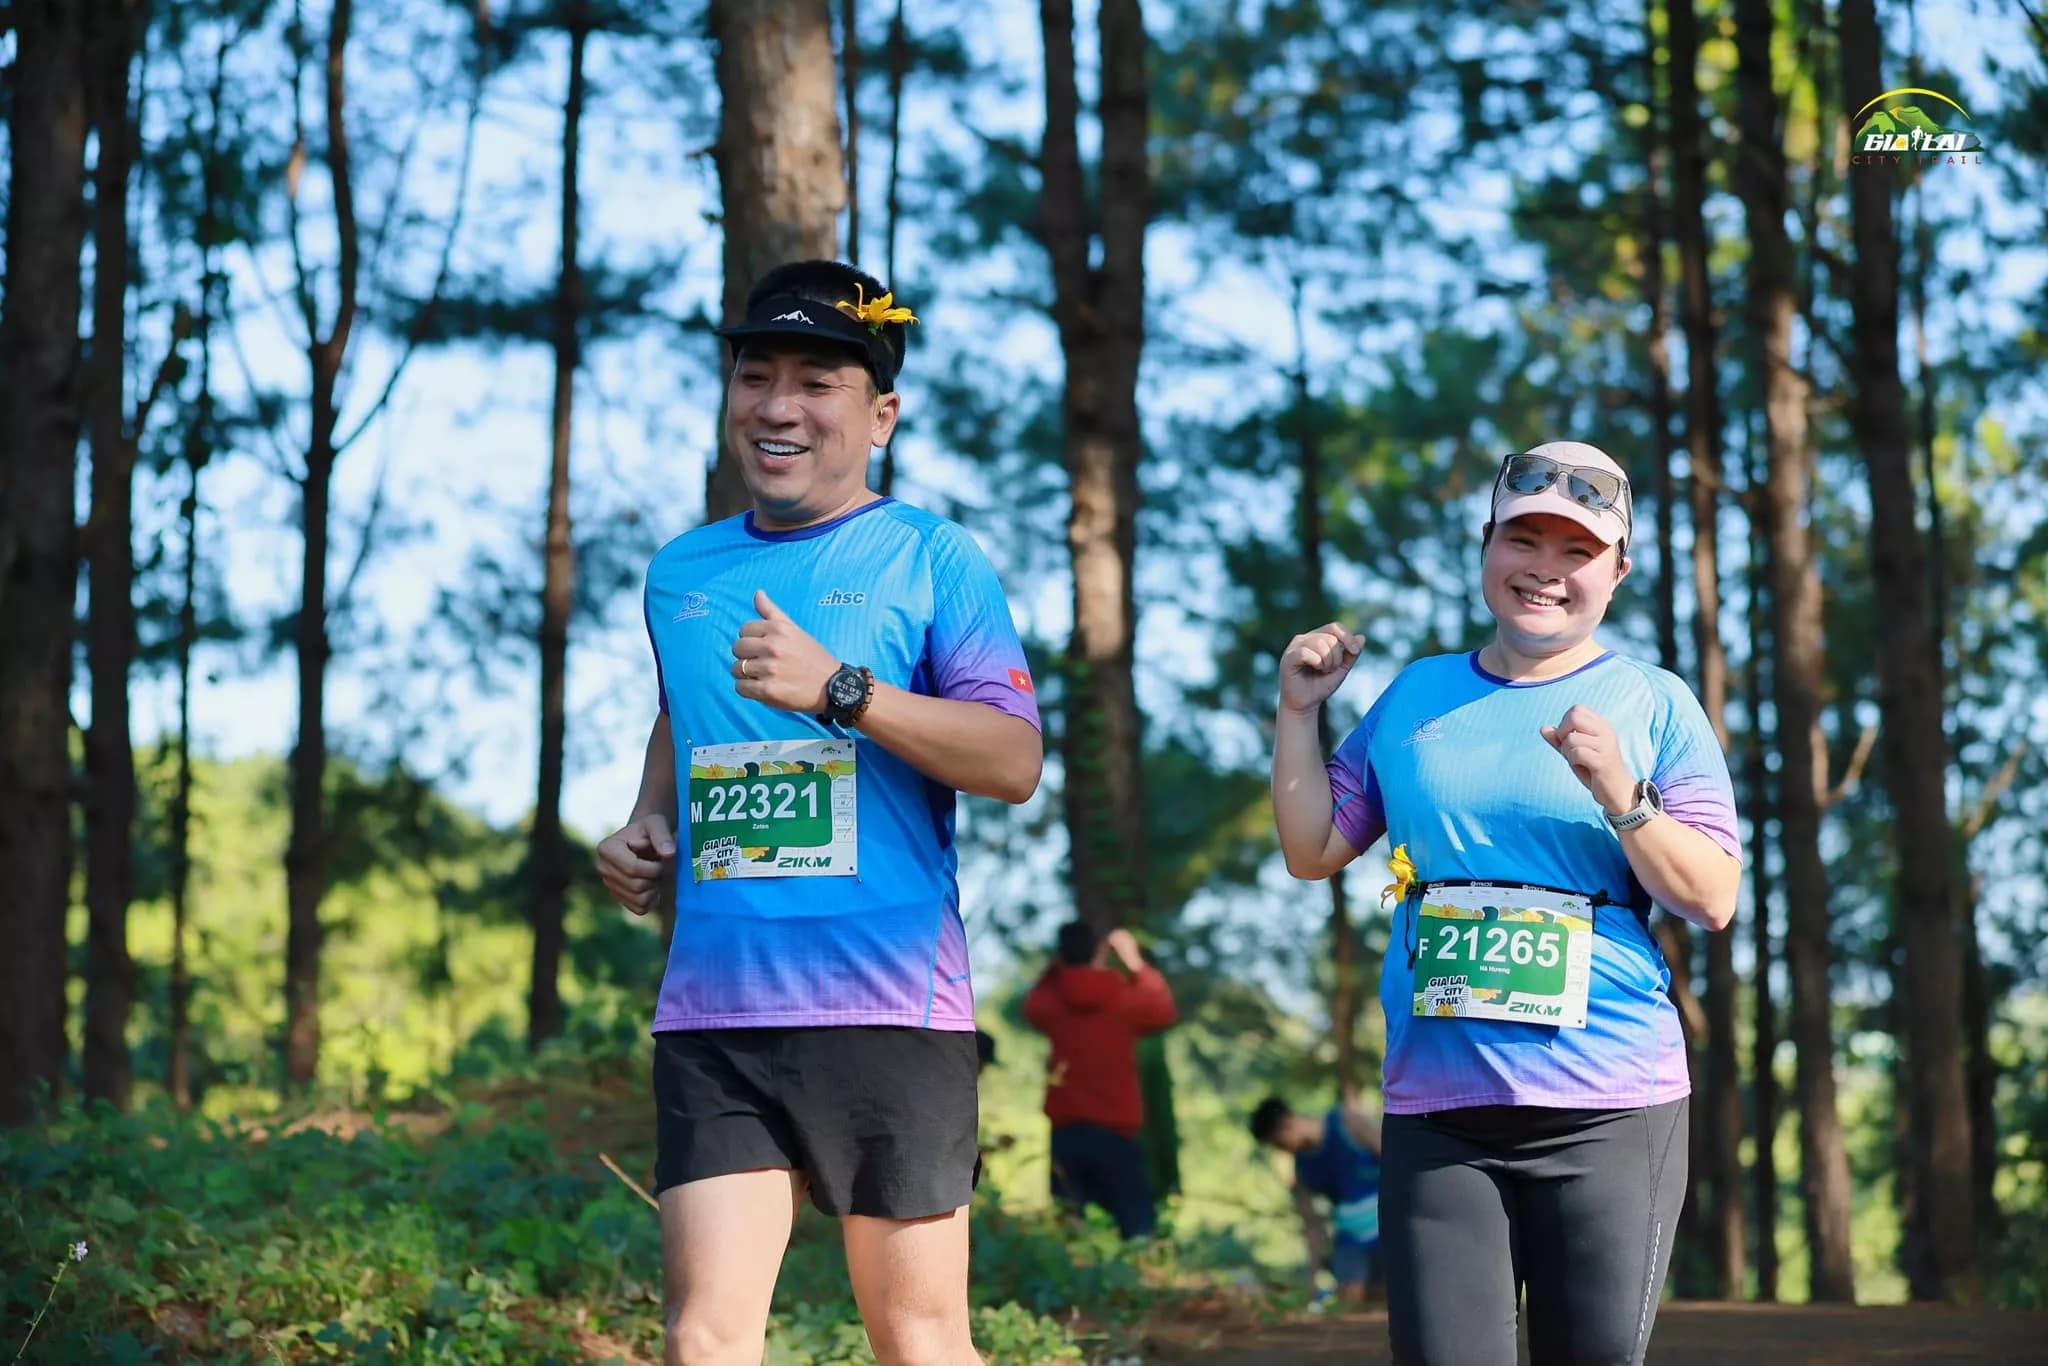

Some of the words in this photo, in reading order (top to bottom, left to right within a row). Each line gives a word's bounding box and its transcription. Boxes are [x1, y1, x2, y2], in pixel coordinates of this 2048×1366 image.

[691, 801, 702, 823] M
[708, 781, 817, 822] 22321
[703, 840, 720, 851] GIA
[720, 836, 737, 847] LAI
[716, 848, 734, 859] CITY
[710, 858, 731, 870] TRAIL
[777, 856, 832, 868] 21KM
[1418, 938, 1429, 960] F
[1436, 925, 1560, 967] 21265
[1429, 977, 1448, 987] GIA
[1448, 975, 1468, 985] LAI
[1443, 986, 1464, 996] CITY
[1435, 996, 1459, 1006] TRAIL
[1508, 1001, 1563, 1016] 21KM
